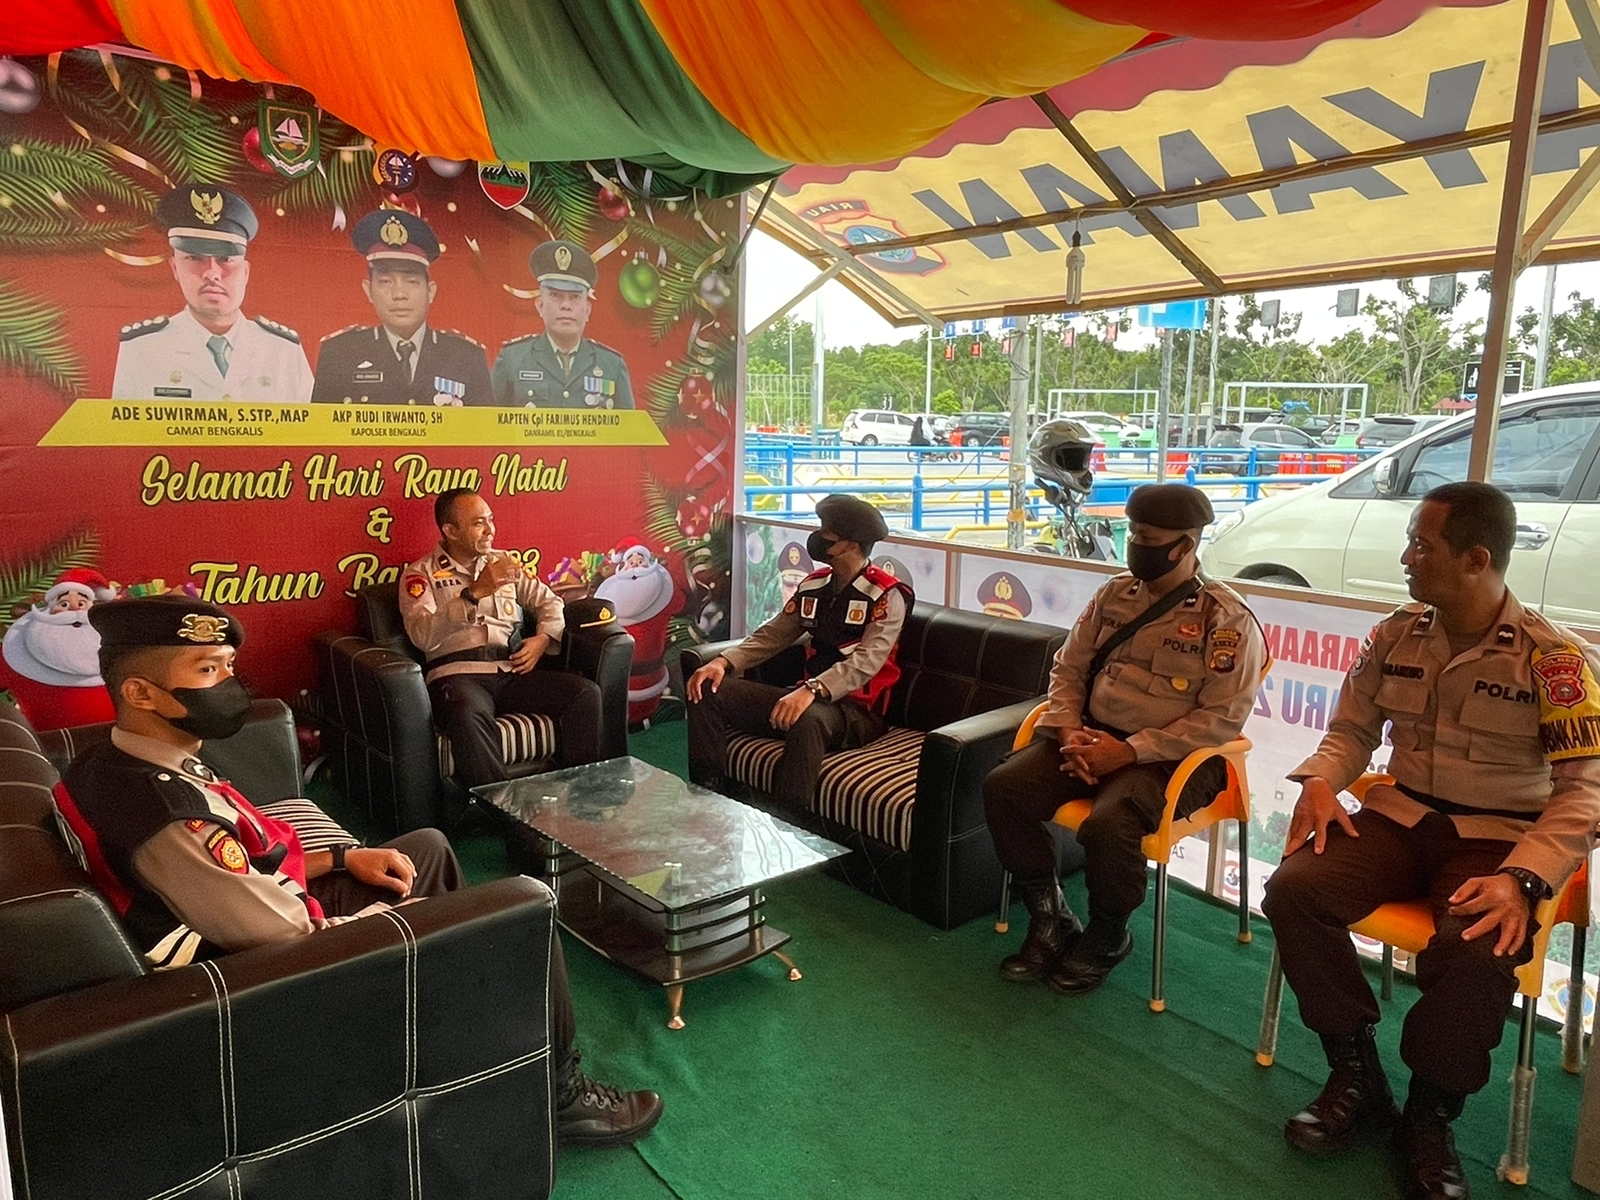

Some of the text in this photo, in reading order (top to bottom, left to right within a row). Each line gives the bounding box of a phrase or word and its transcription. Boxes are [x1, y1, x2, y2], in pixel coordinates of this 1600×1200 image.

[111, 406, 140, 421] ADE
[145, 406, 234, 424] SUWIRMAN,
[332, 410, 443, 426] AKP RUDI IRWANTO, SH
[497, 413, 529, 425] KAPTEN
[545, 414, 580, 426] FARIMUS
[582, 415, 620, 426] HENDRIKO
[166, 426, 264, 437] CAMAT BENGKALIS
[350, 427, 427, 437] KAPOLSEK BENGKALIS
[140, 454, 294, 507] Selamat
[303, 453, 384, 501] Hari
[490, 452, 569, 496] Natal
[365, 506, 394, 544] &
[190, 562, 324, 605] Tahun
[435, 579, 463, 590] REZA
[1473, 679, 1537, 705] POLRI
